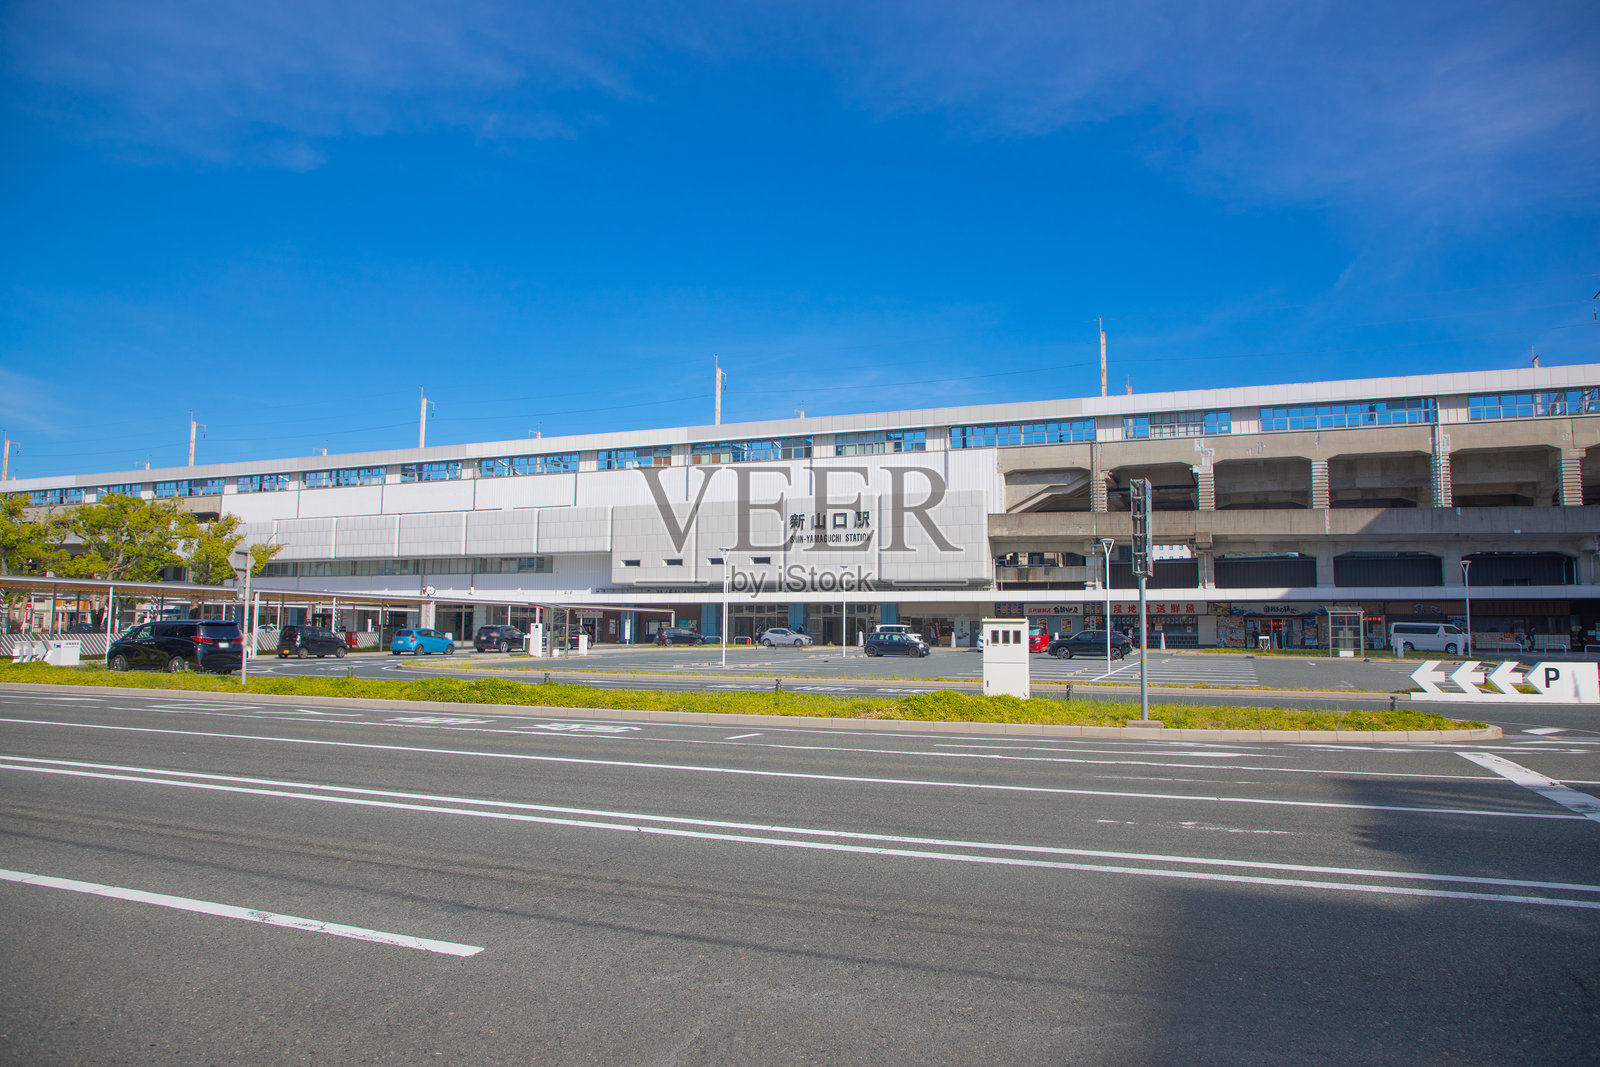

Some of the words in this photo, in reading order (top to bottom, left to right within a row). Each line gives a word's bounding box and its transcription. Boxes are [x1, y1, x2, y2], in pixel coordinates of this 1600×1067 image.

[790, 511, 870, 530] 新山口駅
[790, 534, 842, 544] SHIN-YAMAGUCHI
[845, 532, 871, 542] STATION
[1545, 667, 1560, 688] P
